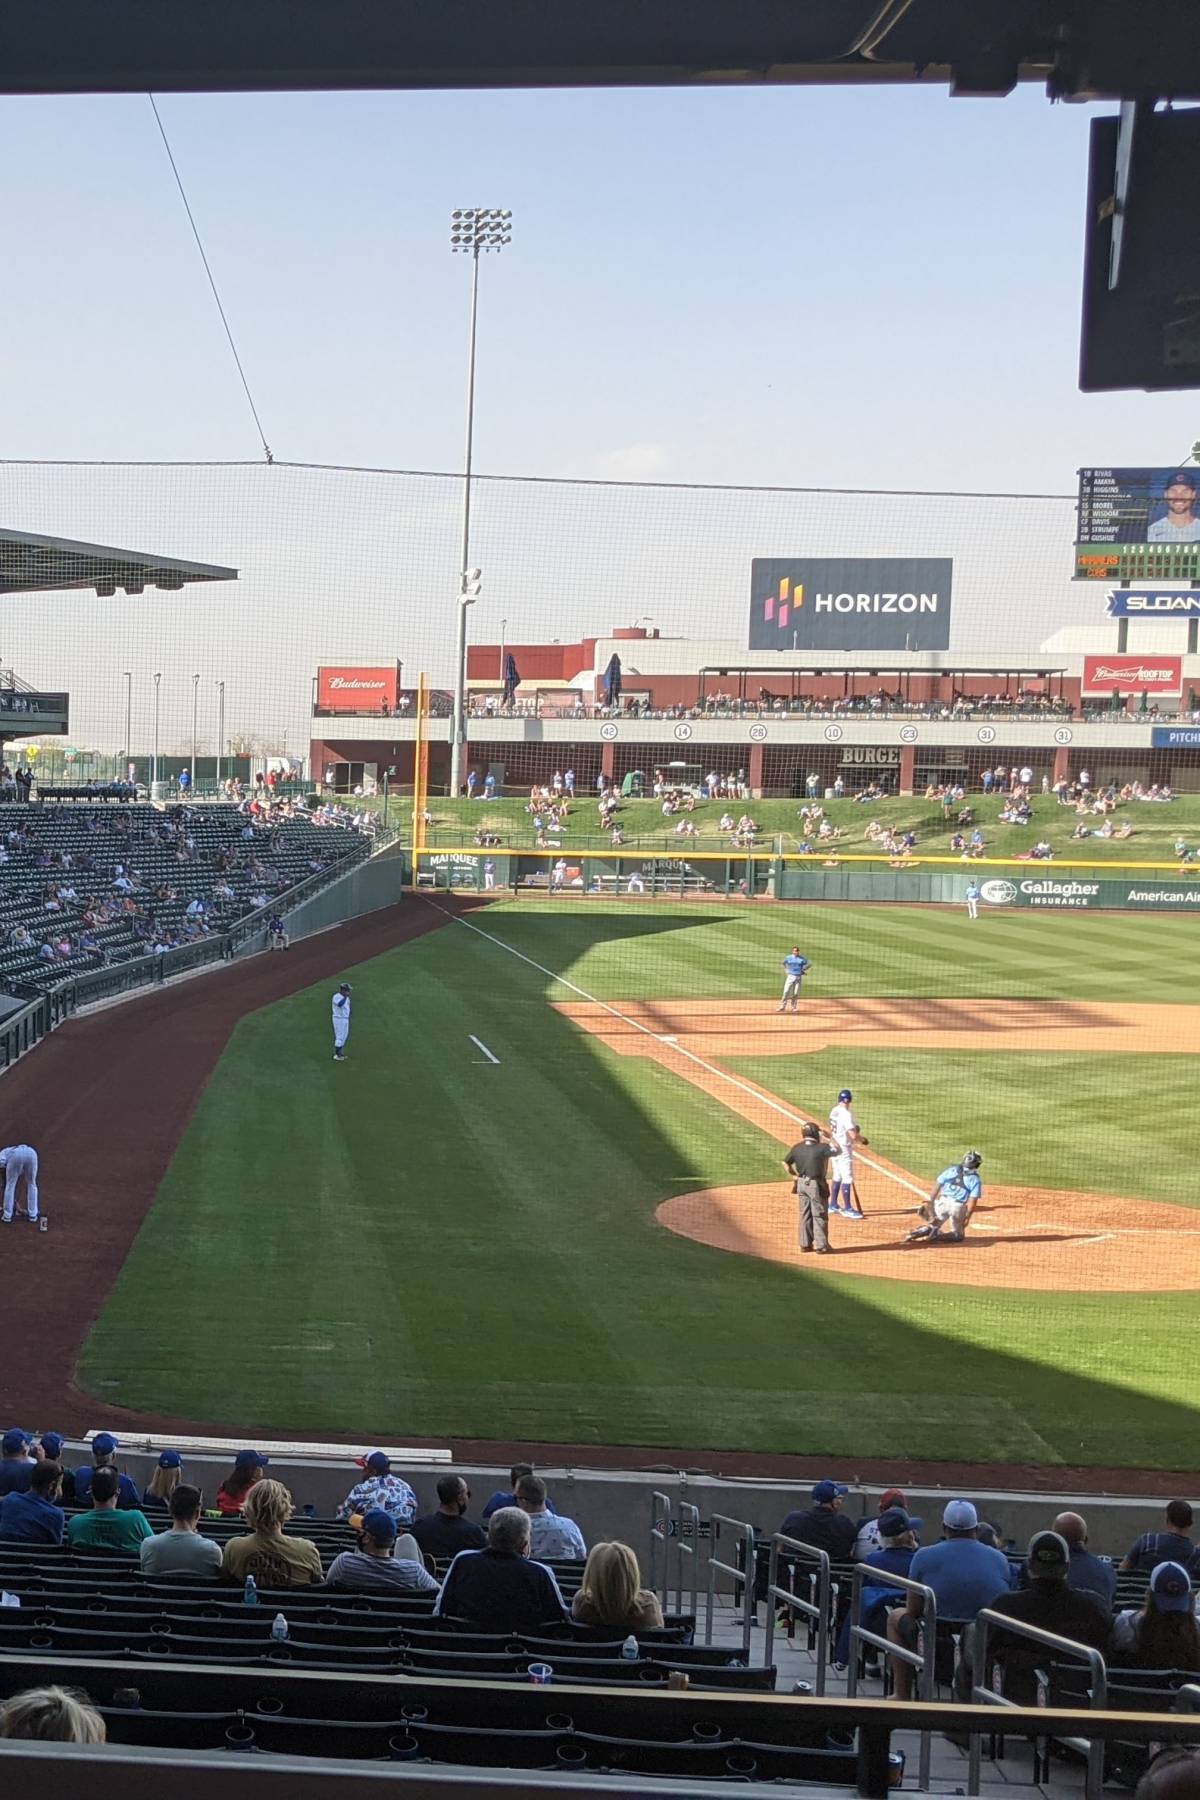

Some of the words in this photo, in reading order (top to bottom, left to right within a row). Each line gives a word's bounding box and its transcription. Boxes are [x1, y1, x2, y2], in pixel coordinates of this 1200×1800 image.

[815, 593, 937, 613] HORIZON
[1126, 596, 1200, 610] SLOAN
[328, 677, 386, 690] Budweiser
[603, 728, 615, 736] 42
[678, 728, 688, 737] 14
[828, 728, 839, 738] 10
[903, 729, 915, 739] 23
[981, 730, 991, 739] 31
[1059, 730, 1069, 740] 31
[842, 748, 901, 763] BURGE
[1020, 880, 1099, 897] Gallagher
[1031, 897, 1088, 905] INSURANCE
[1127, 890, 1184, 902] American
